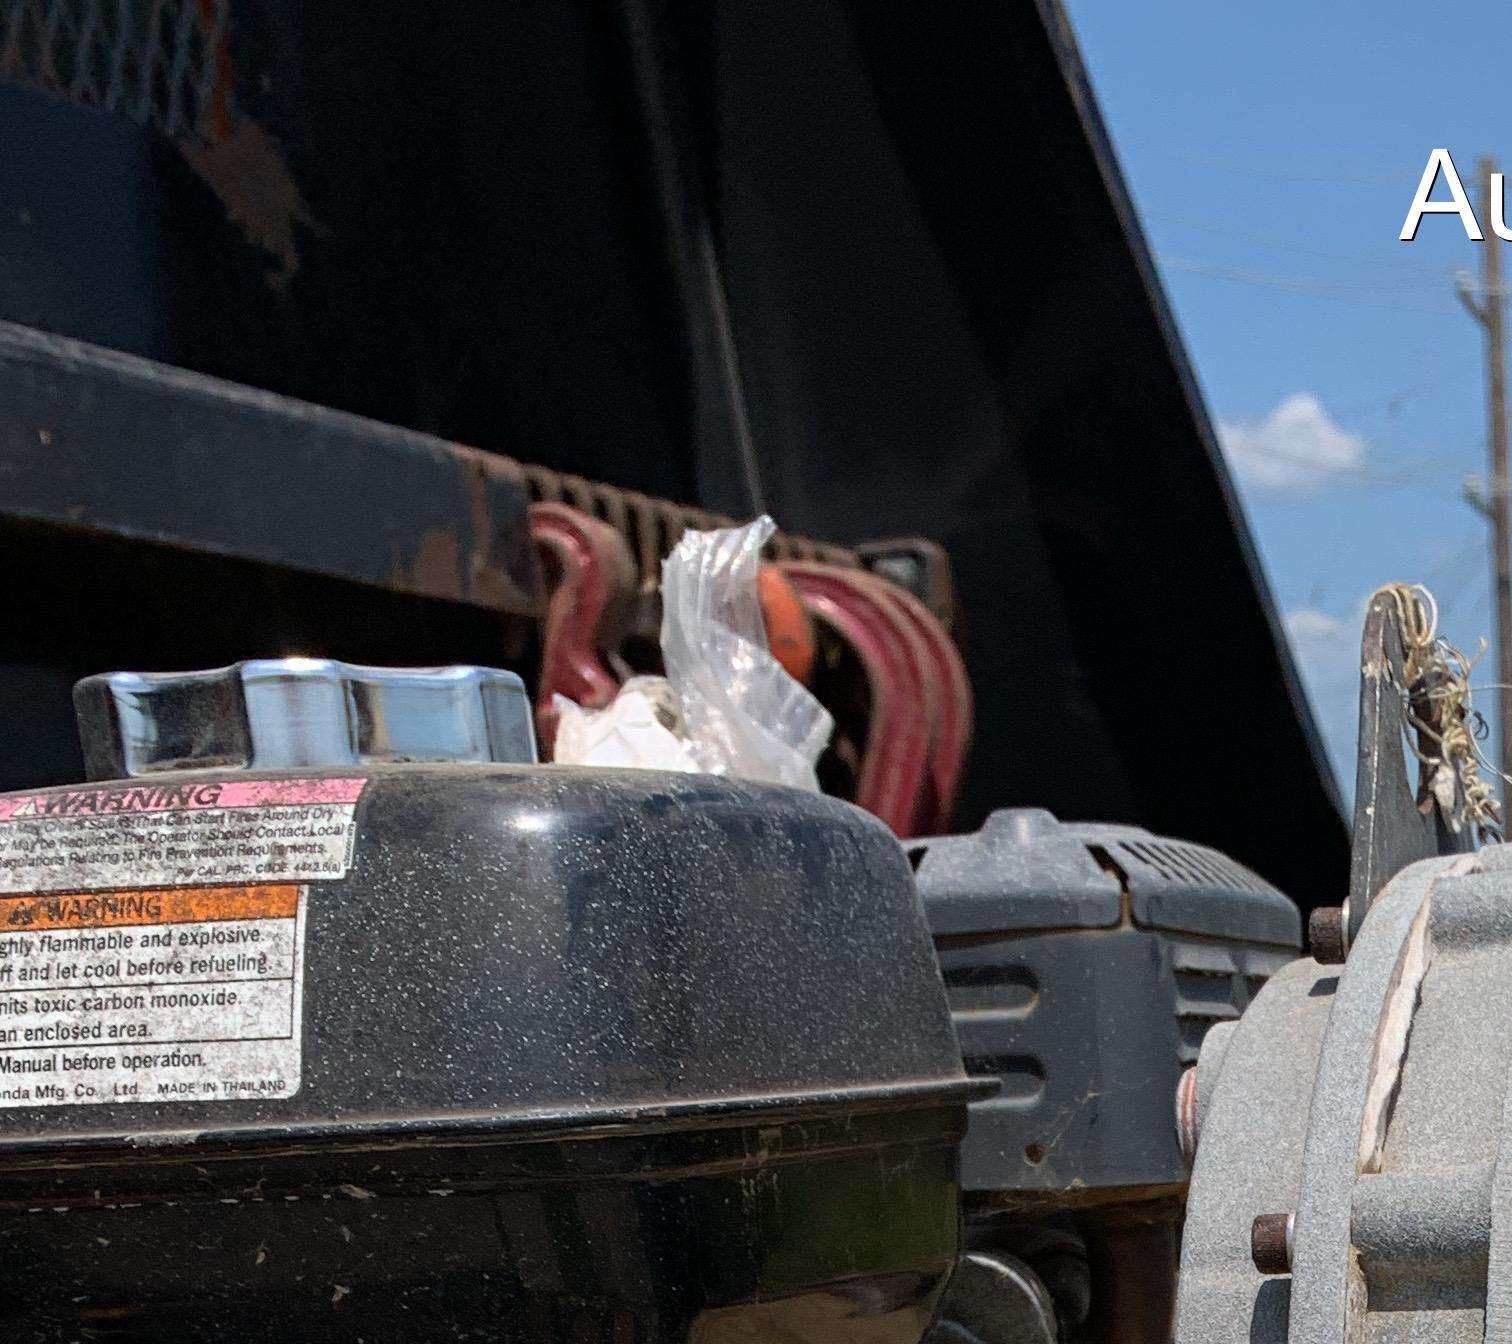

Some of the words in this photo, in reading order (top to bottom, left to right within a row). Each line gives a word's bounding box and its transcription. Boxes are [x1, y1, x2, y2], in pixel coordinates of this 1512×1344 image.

[43, 784, 223, 813] WARNING
[312, 806, 334, 822] Dry
[256, 824, 306, 839] Contact
[48, 896, 161, 921] WARNING
[39, 932, 134, 953] flammable
[140, 931, 171, 948] and
[179, 928, 265, 947] explosive.
[18, 962, 50, 981] and
[56, 961, 77, 980] let
[83, 958, 120, 978] cool
[127, 956, 183, 976] before
[190, 954, 272, 975] refueling.
[34, 995, 76, 1014] toxic
[83, 992, 145, 1012] carbon
[151, 988, 242, 1009] monoxide.
[24, 1021, 102, 1042] enclosed
[108, 1024, 152, 1040] area.
[0, 1053, 56, 1074] Manual
[62, 1052, 116, 1072] before
[121, 1050, 207, 1073] operation.
[35, 1083, 69, 1102] Mfg.
[158, 1081, 195, 1096] MADE
[203, 1081, 216, 1094] IN
[222, 1079, 287, 1094] THAILAND
